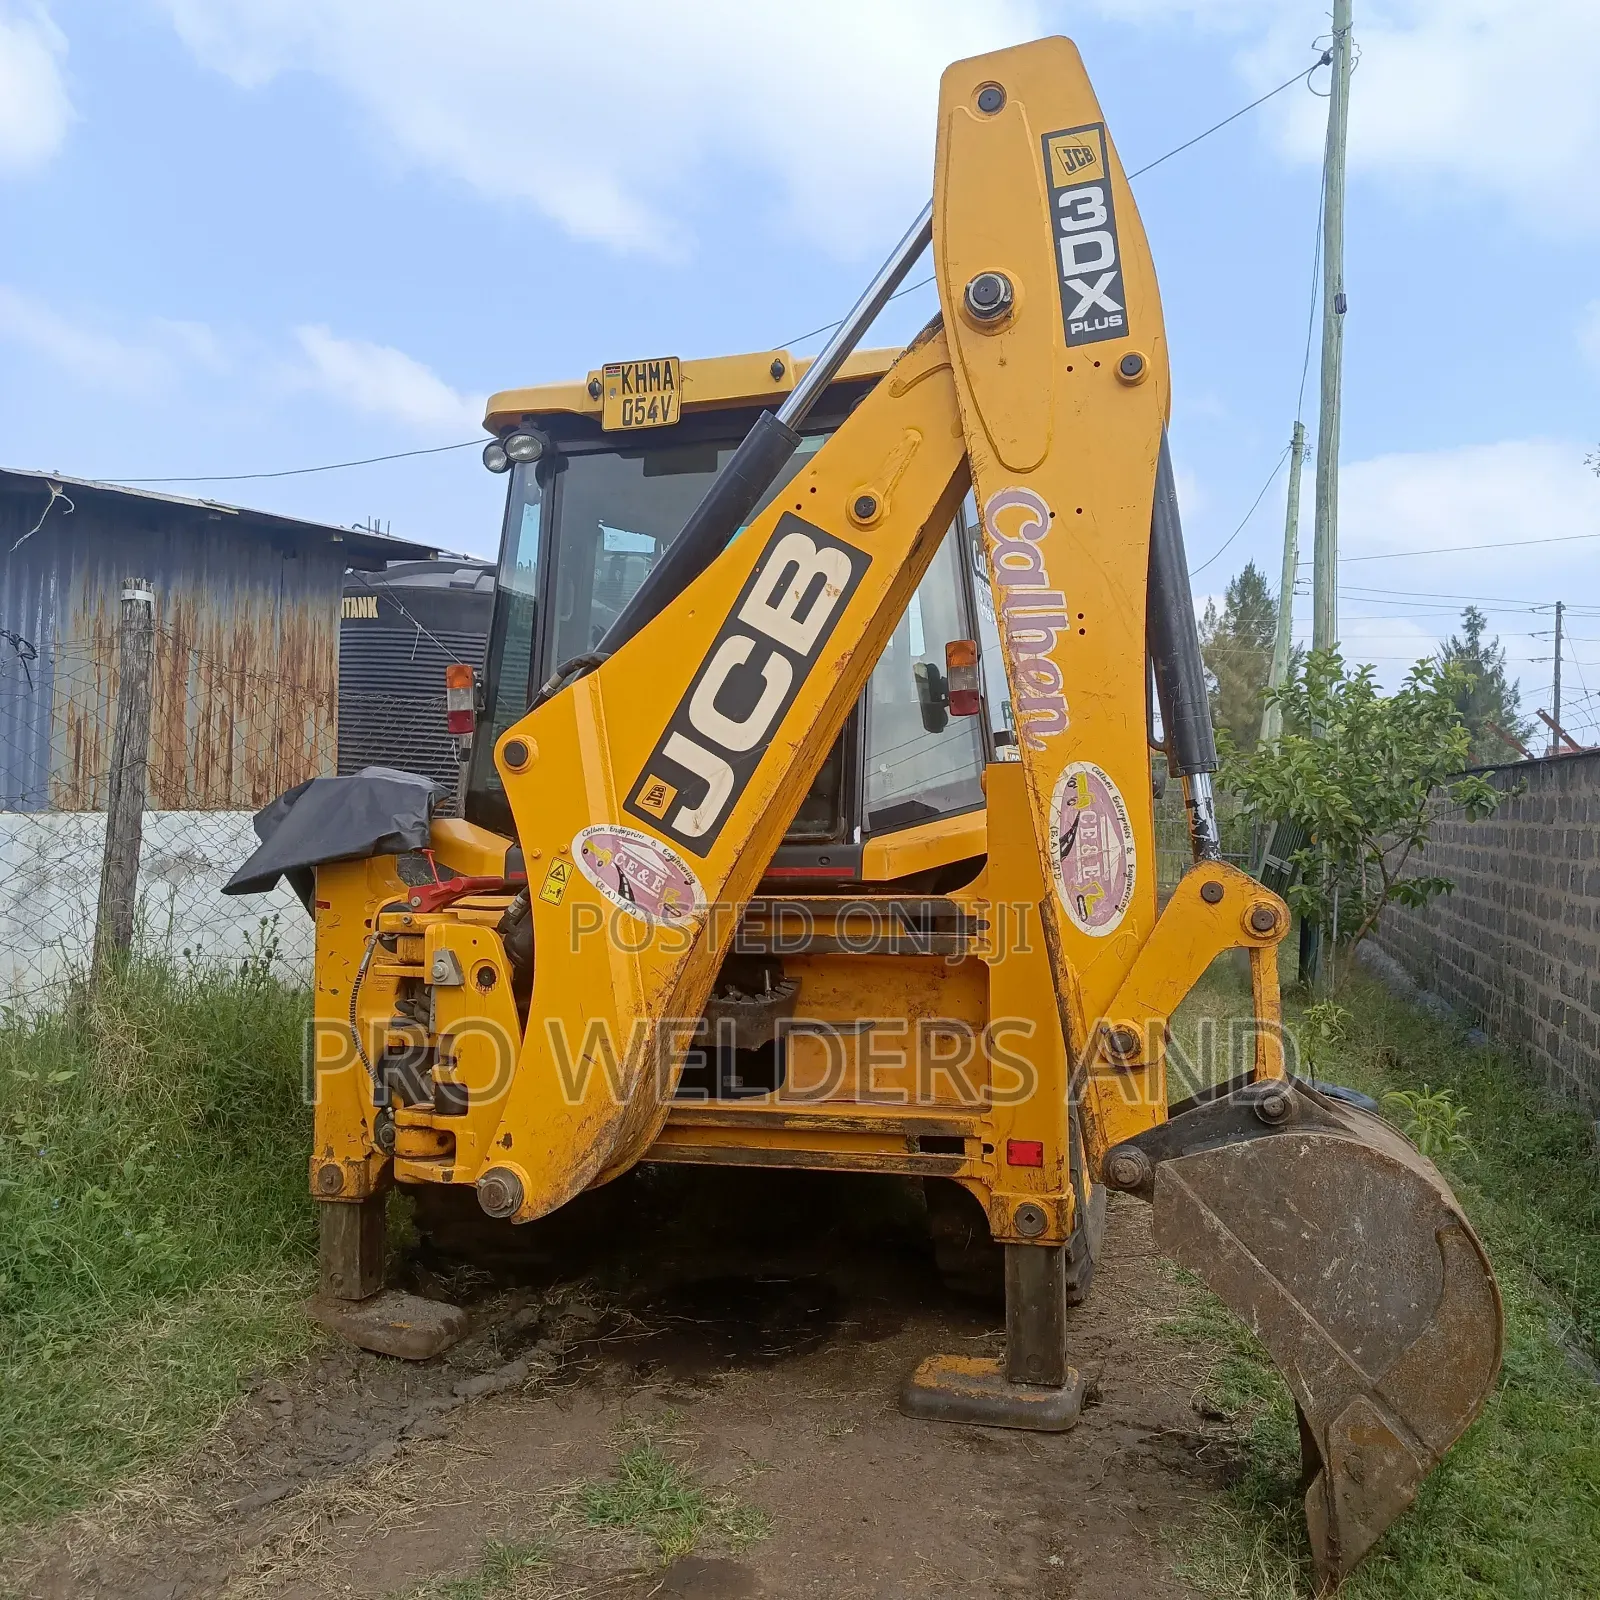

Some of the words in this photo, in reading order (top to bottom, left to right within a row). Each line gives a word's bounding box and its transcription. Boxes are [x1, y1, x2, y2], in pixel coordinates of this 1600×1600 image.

[1063, 147, 1094, 173] JCB
[1058, 186, 1124, 321] 3DX
[1070, 315, 1123, 335] PLUS
[621, 360, 675, 395] KHMA
[622, 394, 673, 427] 054V
[984, 485, 1071, 752] Calben
[662, 532, 852, 838] JCB
[646, 786, 665, 806] JCB
[1111, 795, 1133, 840] Enterprises
